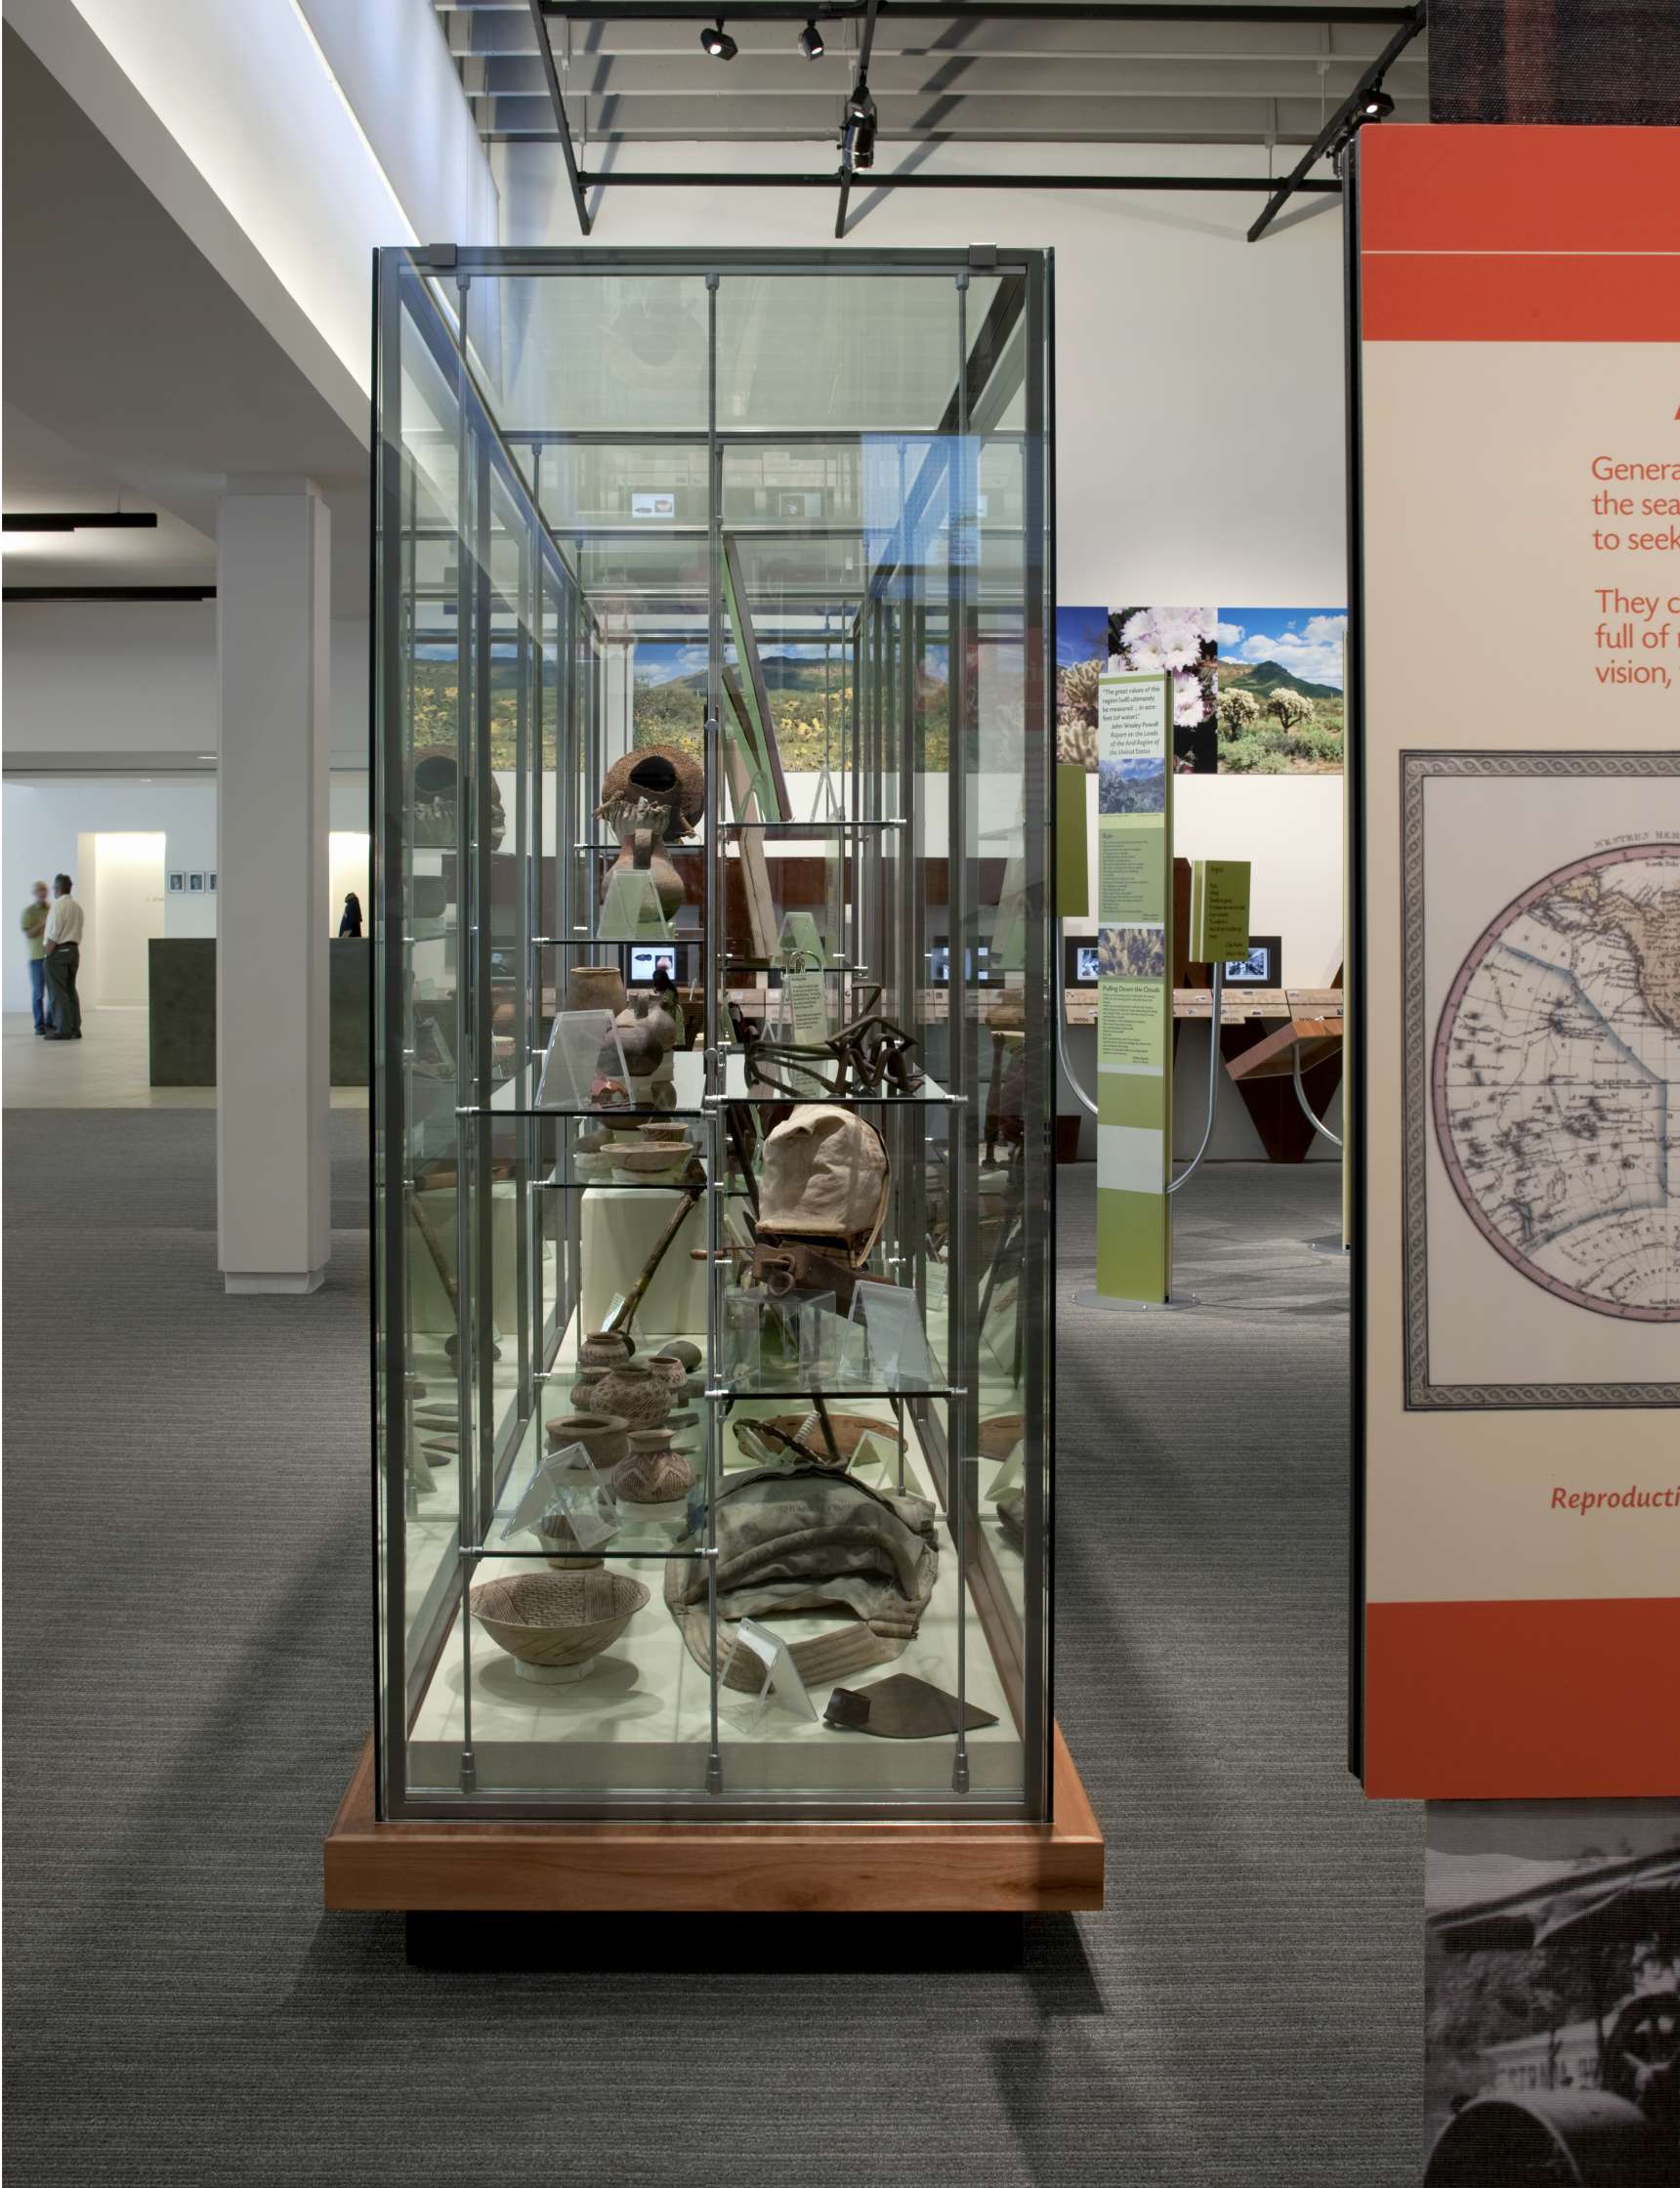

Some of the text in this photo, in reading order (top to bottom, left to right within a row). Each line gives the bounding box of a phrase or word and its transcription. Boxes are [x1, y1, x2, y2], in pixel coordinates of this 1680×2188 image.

[1592, 456, 1680, 481] Genera
[1591, 490, 1680, 516] the sea
[1592, 525, 1680, 551] to seek
[1594, 588, 1659, 622] They
[1595, 623, 1633, 649] full
[1642, 623, 1671, 649] of
[1595, 659, 1671, 690] vision,
